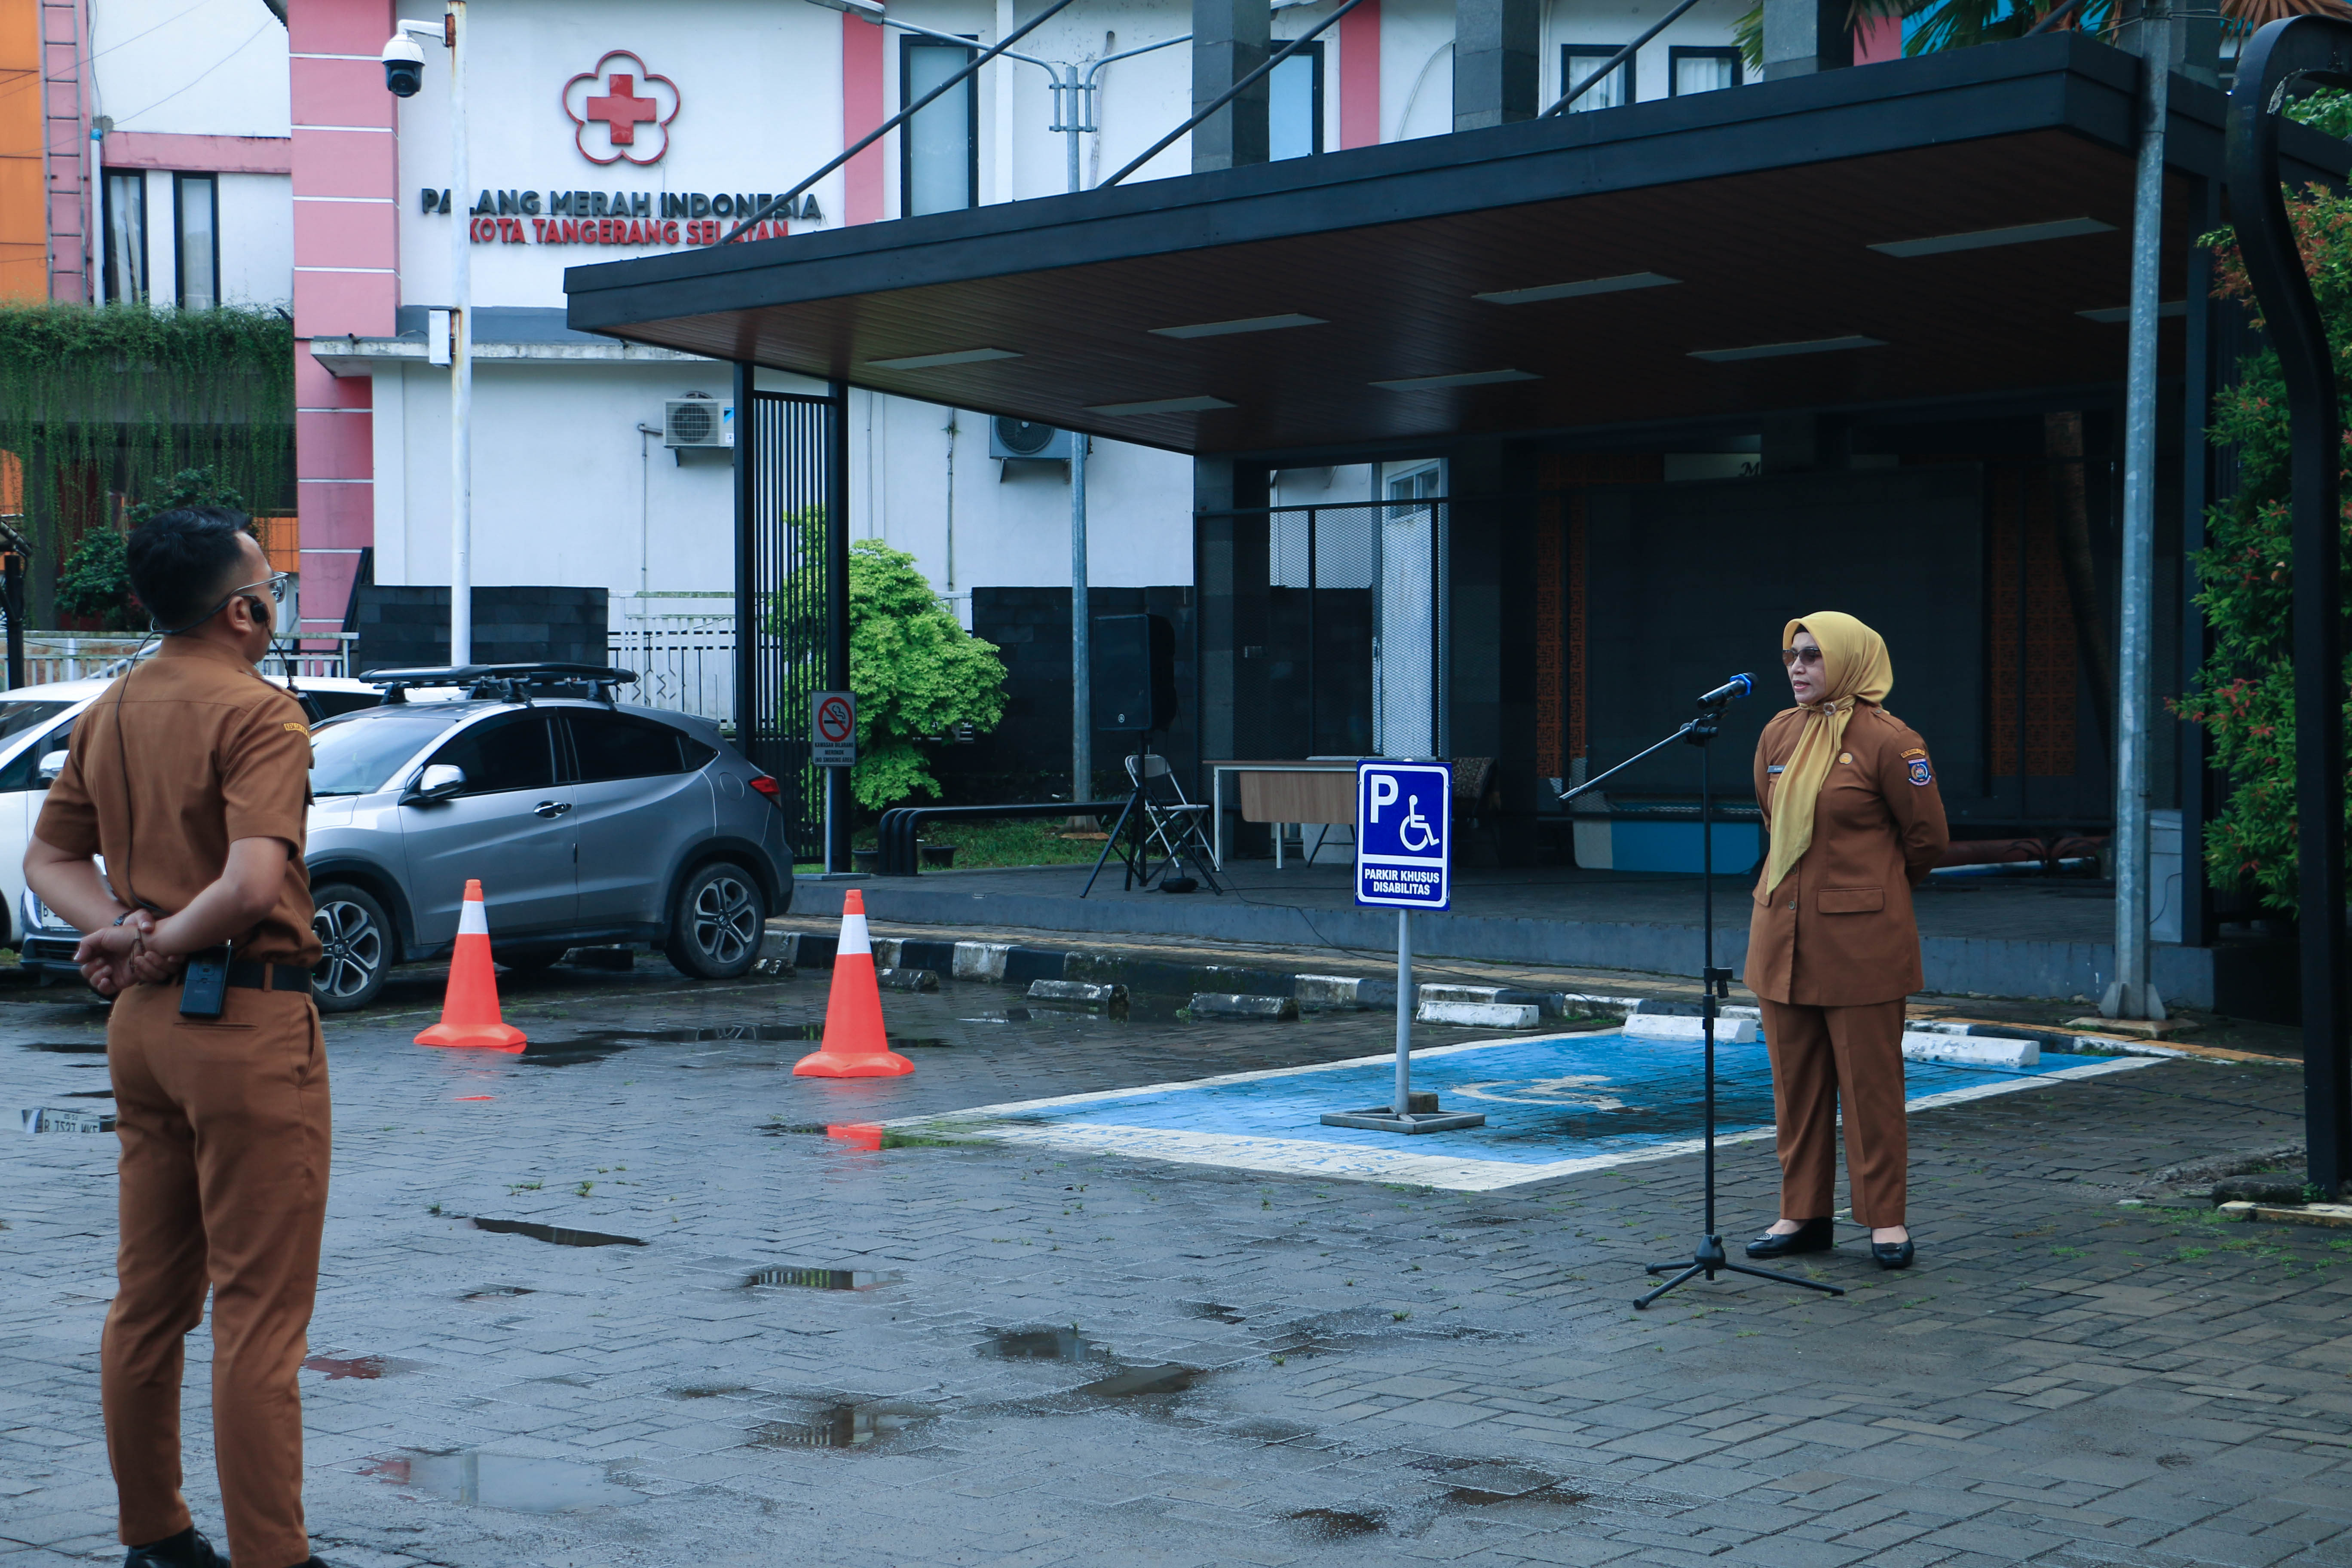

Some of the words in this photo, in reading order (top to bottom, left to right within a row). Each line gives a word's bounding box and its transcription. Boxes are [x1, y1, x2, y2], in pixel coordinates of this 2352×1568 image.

[422, 188, 540, 215] PAANG
[550, 191, 651, 217] MERAH
[661, 192, 822, 219] INDONESIA
[532, 219, 680, 244] TANGERANG
[1370, 774, 1399, 823] P
[1364, 868, 1398, 881] PARKIR
[1400, 870, 1440, 884] KHUSUS
[1373, 881, 1430, 895] DISABILITAS
